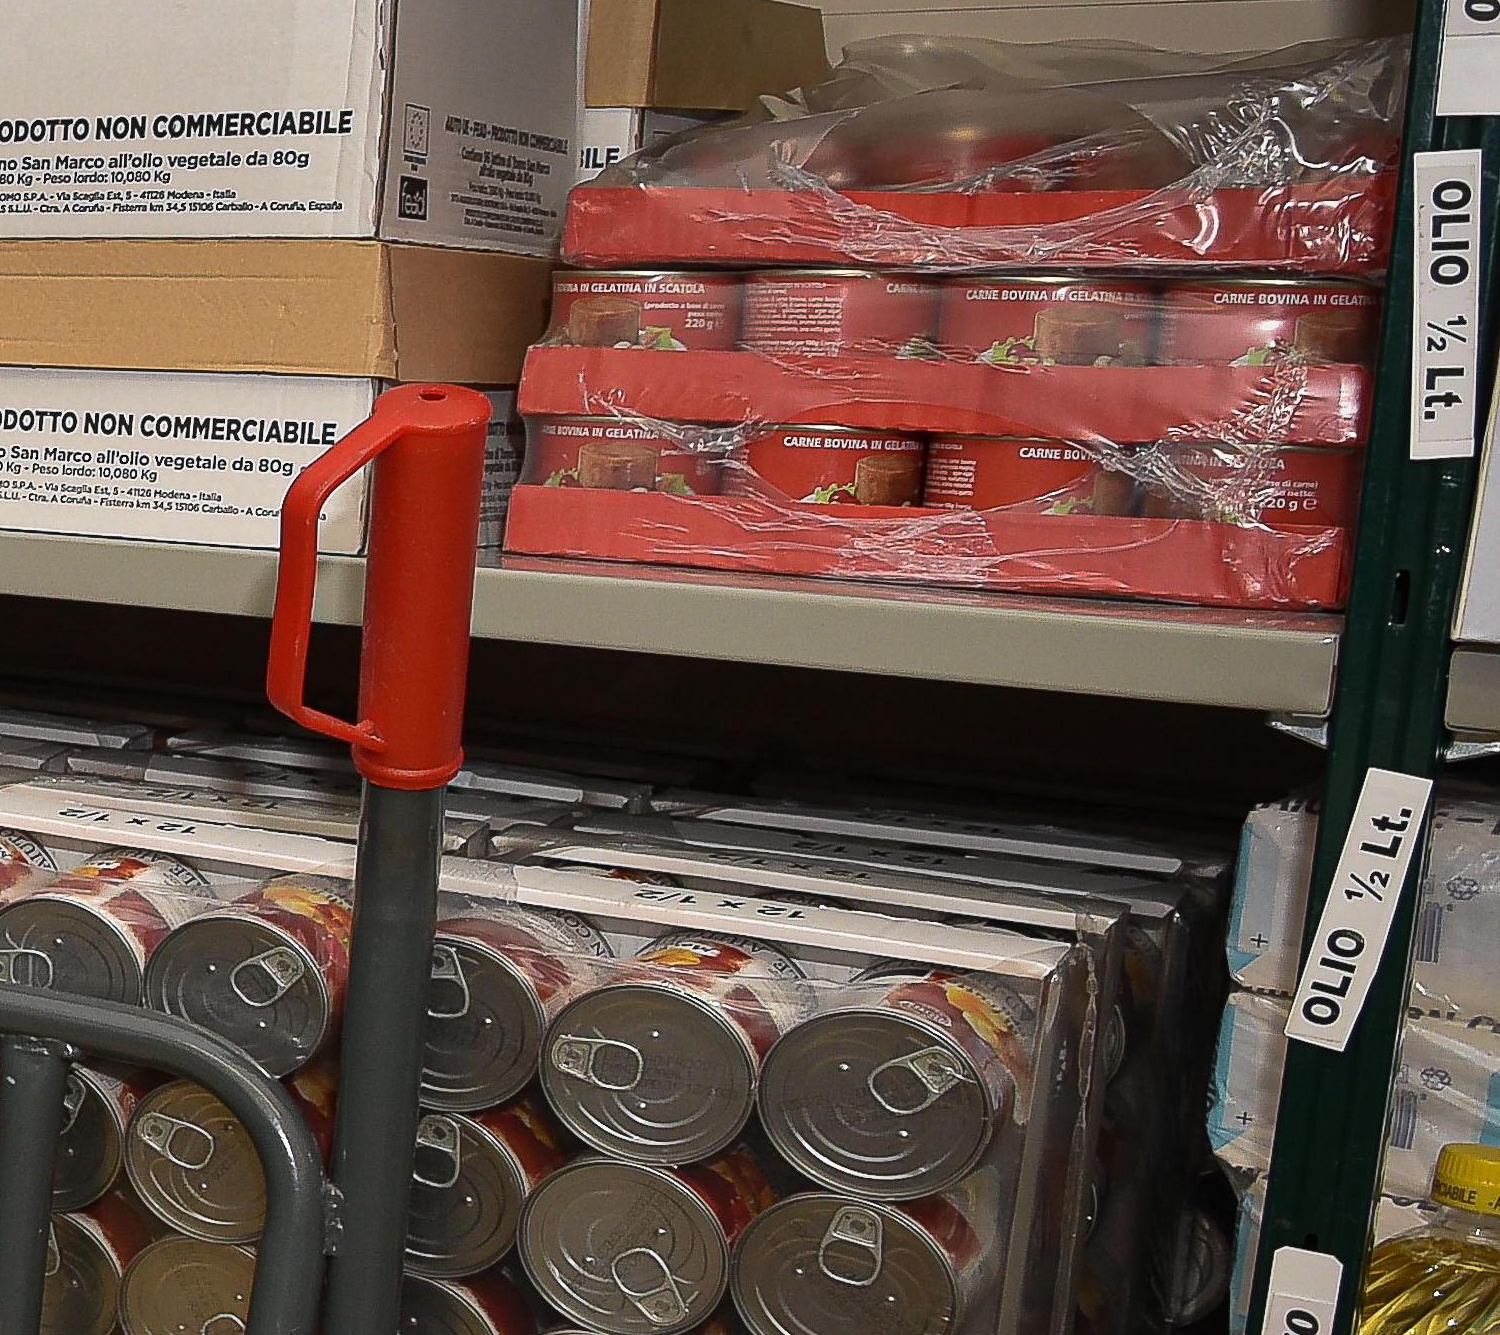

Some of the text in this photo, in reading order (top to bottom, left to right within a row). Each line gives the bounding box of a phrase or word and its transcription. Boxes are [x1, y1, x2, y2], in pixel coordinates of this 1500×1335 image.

[95, 114, 146, 141] NON
[152, 110, 353, 139] COMMERCIABILE
[22, 155, 53, 171] San
[57, 154, 105, 171] Marco
[167, 151, 241, 170] vegetale
[245, 150, 267, 167] da
[272, 150, 310, 168] 80g
[17, 173, 33, 188] Kg
[43, 173, 72, 185] Peso
[74, 171, 108, 184] lordo:
[154, 171, 171, 185] Kg
[1428, 179, 1472, 286] OLIO
[591, 282, 642, 294] GELATINA
[644, 282, 658, 294] IN
[966, 289, 999, 301] CARNE
[1001, 290, 1047, 302] BOVINA
[1213, 293, 1327, 305] CARNE BOVINA IN
[1423, 366, 1466, 421] Lt.
[83, 412, 134, 437] NON
[139, 415, 338, 446] COMMERCIABILE
[783, 436, 822, 448] CARNE
[823, 437, 869, 450] BOVINA
[10, 445, 39, 461] San
[43, 447, 92, 464] Marco
[154, 453, 227, 473] vegetale
[231, 456, 254, 473] da
[258, 458, 294, 477] 80g
[1301, 928, 1366, 1026] OLIO
[1360, 807, 1412, 859] Lt.
